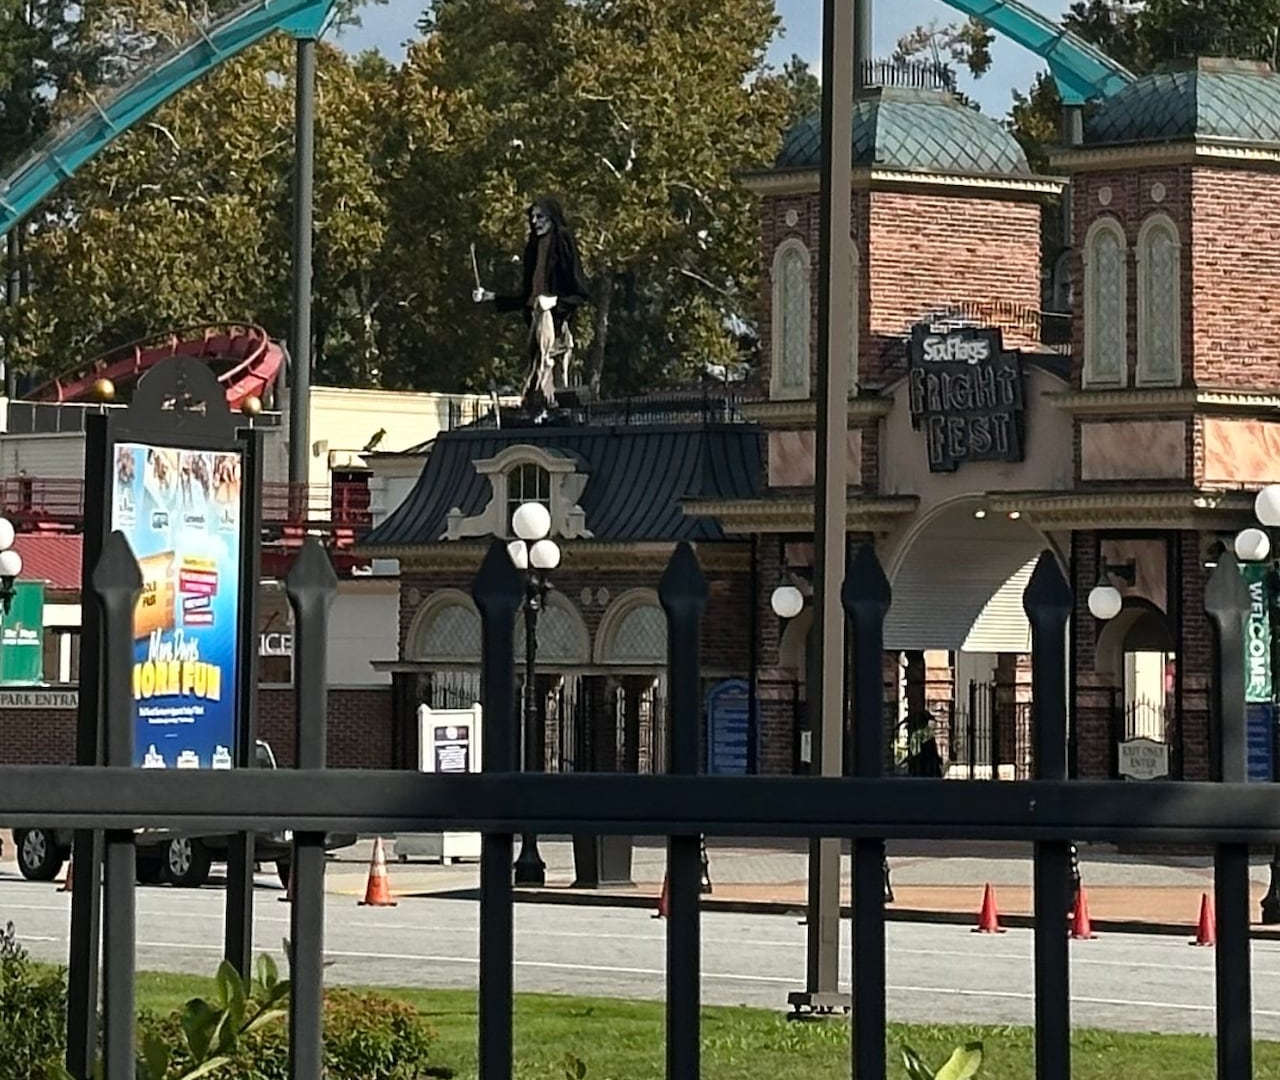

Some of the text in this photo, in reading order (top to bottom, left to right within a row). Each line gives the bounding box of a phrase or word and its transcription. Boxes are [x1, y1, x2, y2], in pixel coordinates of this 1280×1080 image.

[910, 366, 1017, 414] FRIGHT
[929, 413, 1010, 464] FEST
[1249, 582, 1265, 688] WELCOME
[0, 693, 32, 706] PARK
[182, 661, 221, 701] FUN
